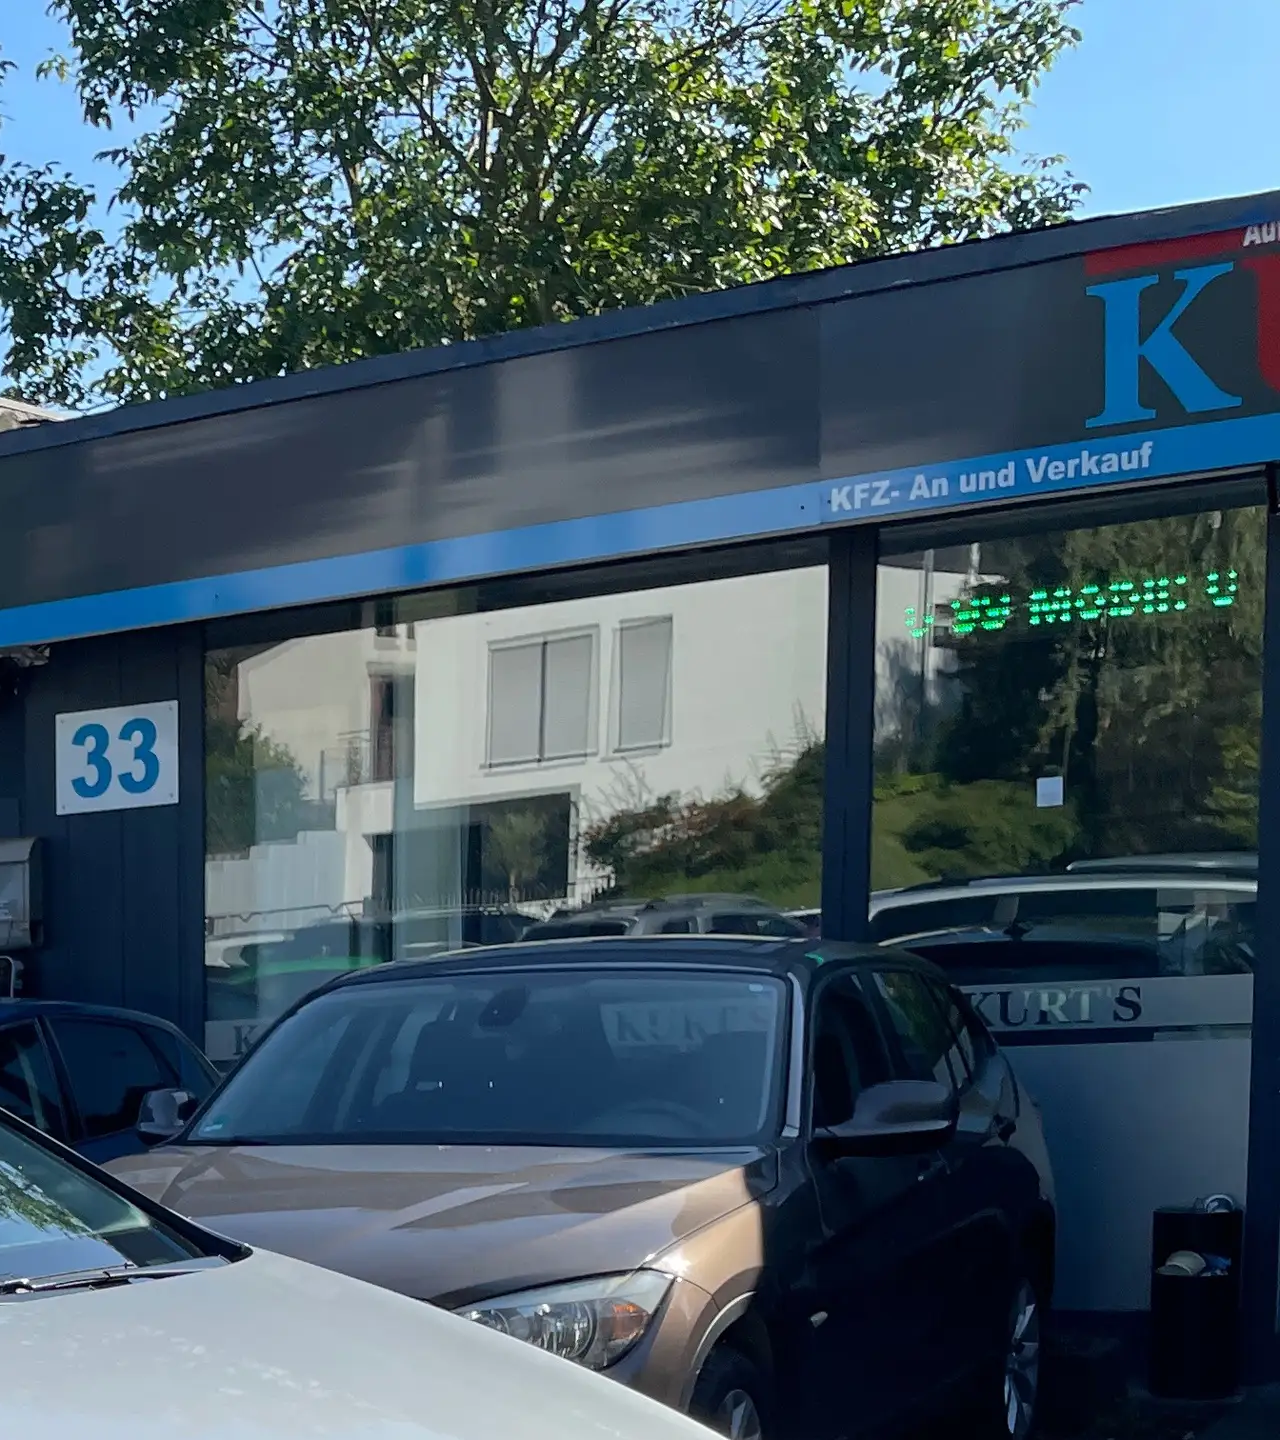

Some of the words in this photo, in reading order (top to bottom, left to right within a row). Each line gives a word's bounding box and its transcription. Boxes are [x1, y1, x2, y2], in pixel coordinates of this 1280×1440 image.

[1085, 257, 1280, 429] K
[830, 480, 900, 512] KFZ-
[909, 473, 949, 501] An
[959, 461, 1015, 493] und
[1025, 441, 1153, 484] Verkauf
[70, 717, 160, 798] 33
